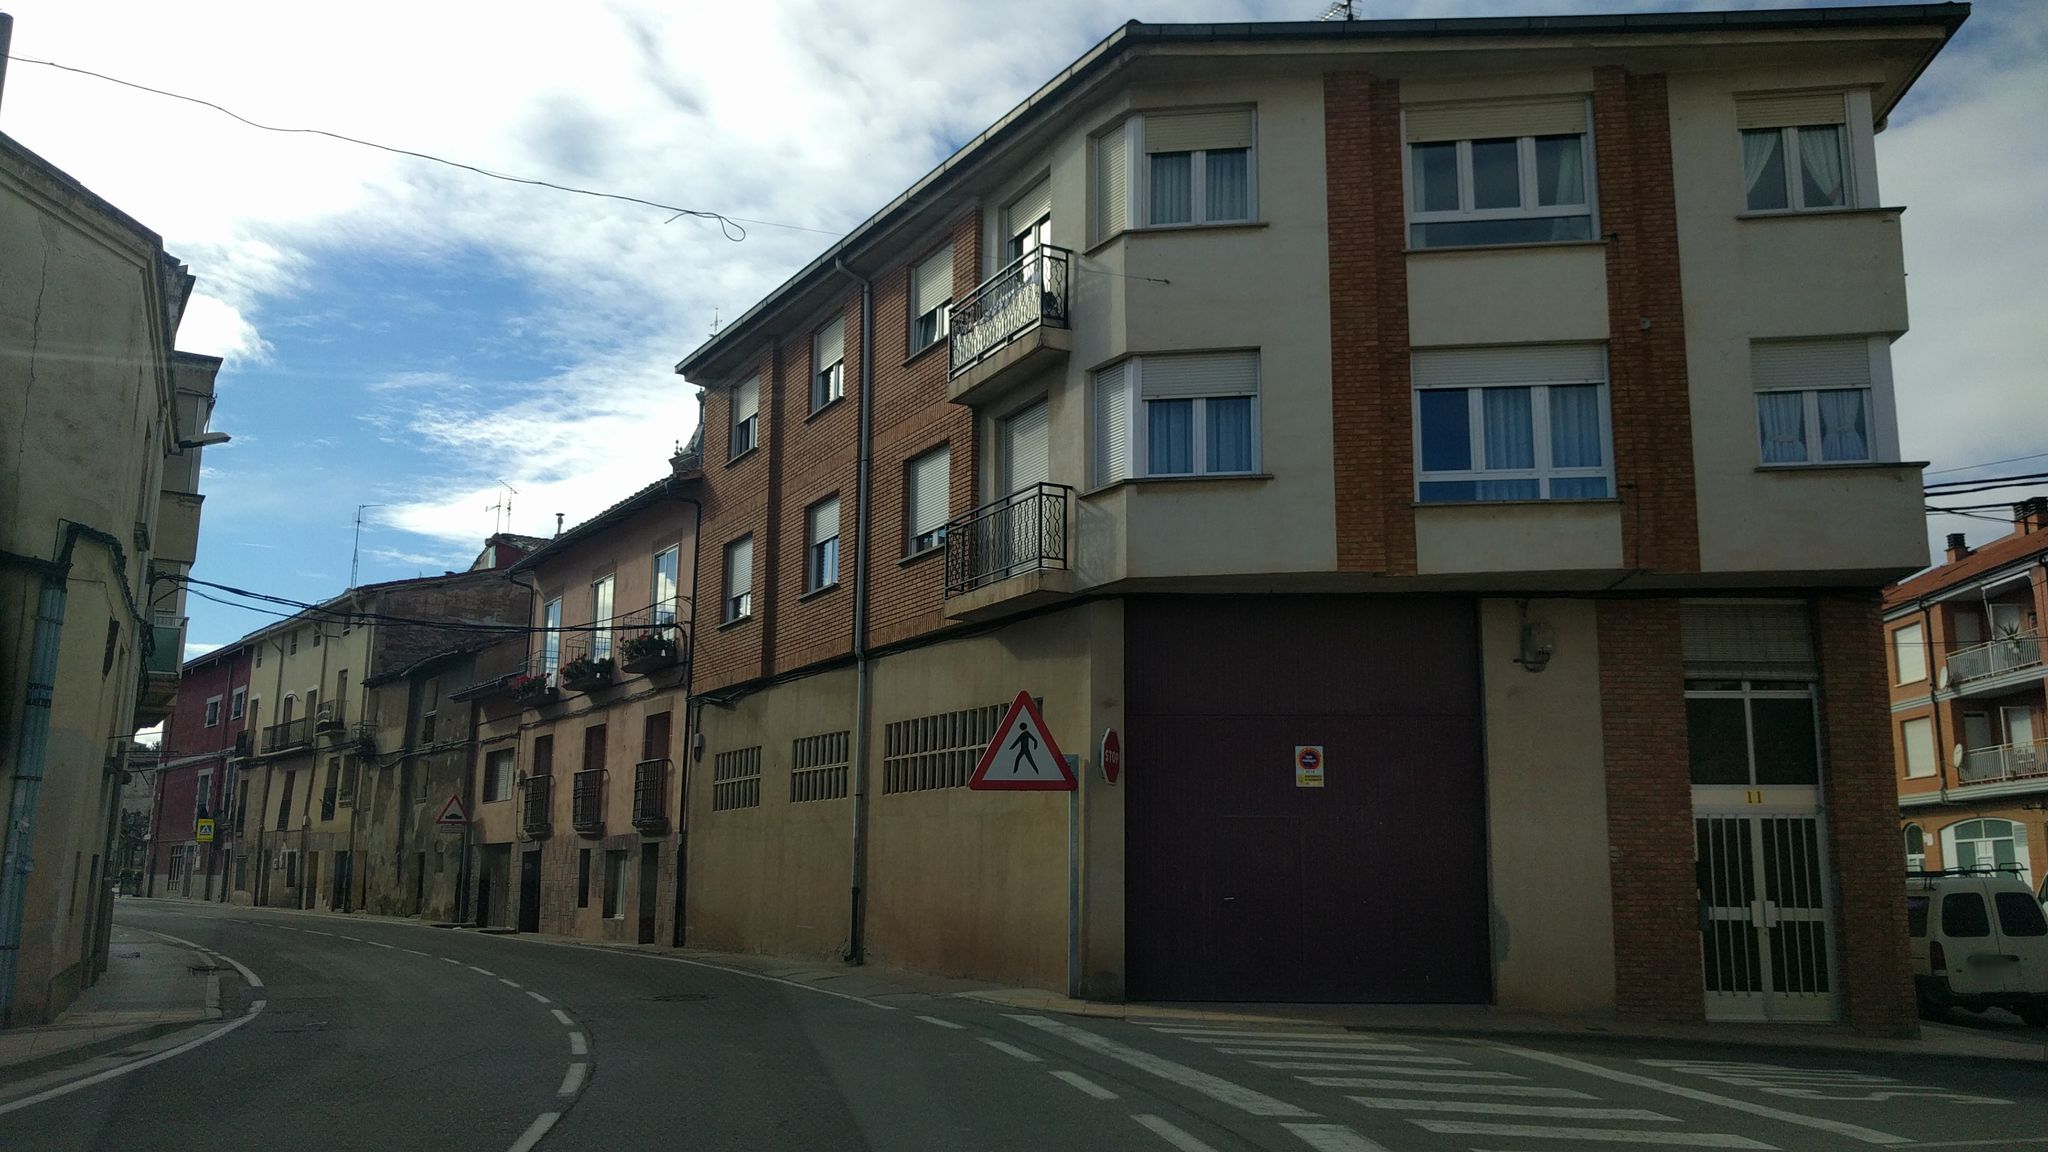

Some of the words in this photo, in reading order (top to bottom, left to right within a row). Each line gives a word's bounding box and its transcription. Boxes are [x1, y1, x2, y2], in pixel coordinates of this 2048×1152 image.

[1104, 750, 1119, 764] STOP
[1747, 790, 1762, 804] 11
[1636, 1059, 2016, 1105] STOP
